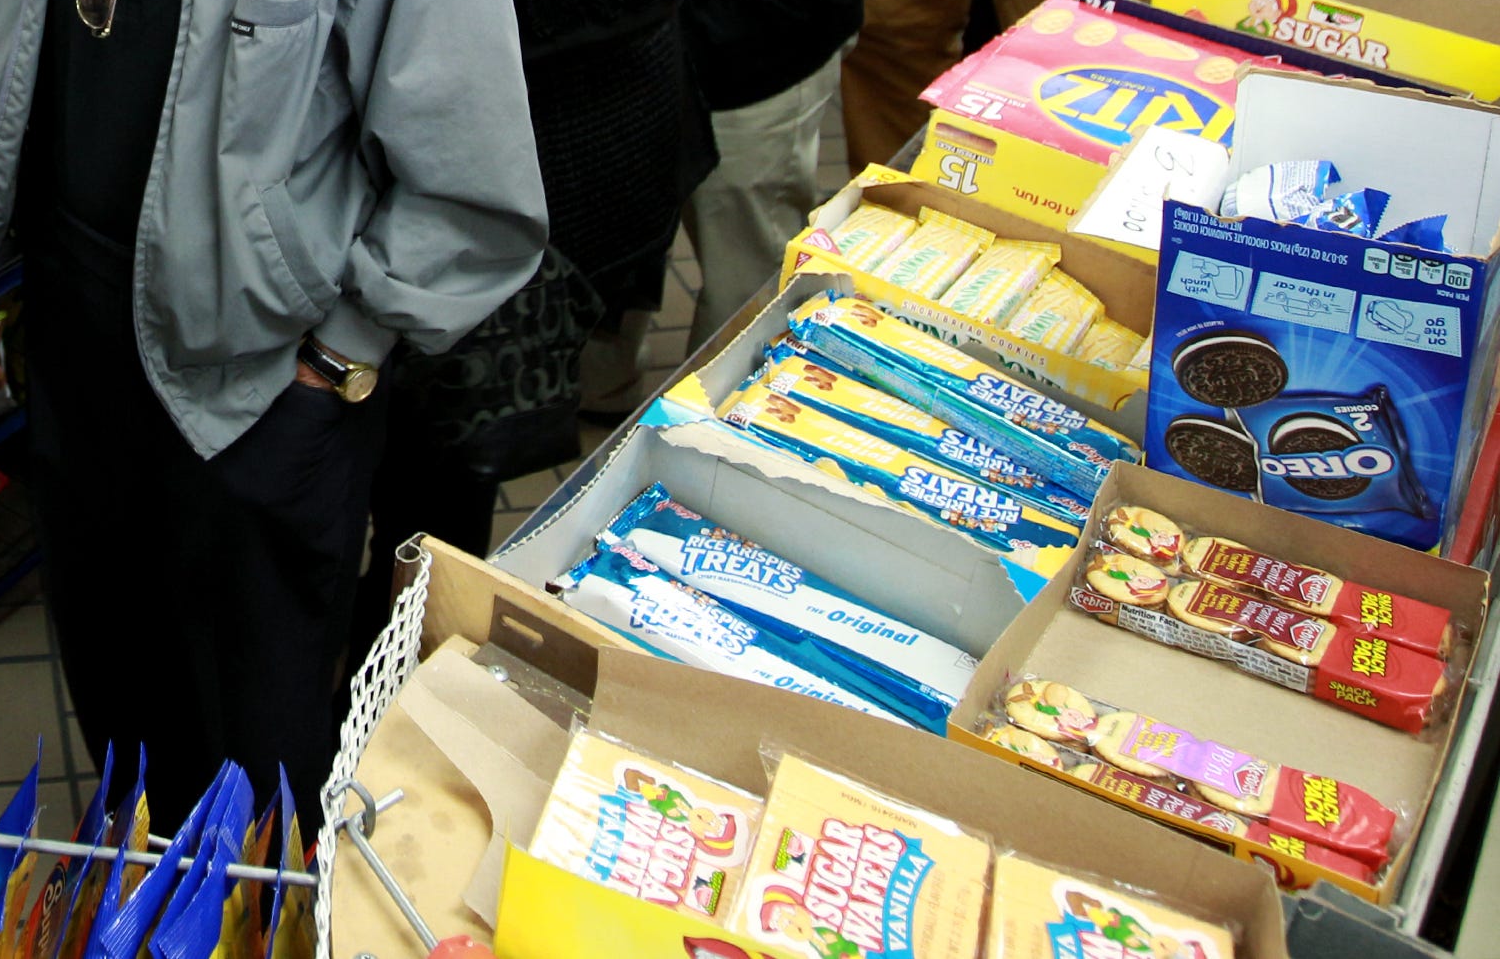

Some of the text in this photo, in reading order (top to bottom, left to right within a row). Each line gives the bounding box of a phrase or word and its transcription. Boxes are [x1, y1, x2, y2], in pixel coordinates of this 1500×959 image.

[1274, 15, 1390, 70] SUGAR
[1089, 73, 1156, 92] CRACKERS
[955, 94, 1004, 121] 15
[1050, 74, 1235, 143] RITZ
[938, 154, 980, 195] 15
[1011, 185, 1041, 205] fun.
[1040, 195, 1061, 213] for
[1172, 219, 1200, 236] COOKIES
[1200, 225, 1233, 243] SANDWICH
[1234, 232, 1270, 251] CHOCOLATE
[1269, 240, 1291, 255] PACKS
[1180, 277, 1211, 289] lunch
[1184, 284, 1209, 295] with
[1271, 280, 1337, 300] in the car
[1447, 276, 1469, 288] 100
[1456, 293, 1470, 302] PER
[902, 300, 1047, 367] SHORTBREAD COOKIES
[1424, 327, 1448, 338] the
[1426, 317, 1445, 329] go
[1428, 337, 1447, 348] on
[967, 386, 1086, 430] RICE KRISPIES
[979, 372, 1091, 422] TREATS
[1333, 405, 1379, 414] COOKIES
[1350, 413, 1374, 432] 2
[938, 439, 1019, 479] KRISPIES
[1262, 447, 1394, 479] OREO
[898, 479, 1019, 524] RICE KRISPIES
[906, 464, 1023, 515] TREATS
[680, 547, 798, 595] TREATS
[687, 535, 804, 579] RICE KRISPIES
[1071, 587, 1114, 614] Keebler
[1359, 591, 1380, 629] PACK
[1376, 592, 1394, 629] SNACK
[805, 605, 919, 647] THE Original
[1121, 604, 1181, 630] Nutrition Facts
[1351, 637, 1371, 677] PACK
[1369, 638, 1388, 677] SNACK
[752, 668, 771, 680] THE
[1328, 681, 1372, 700] SNACK
[1335, 689, 1377, 709] PACK
[1302, 773, 1328, 827] PACK
[1318, 777, 1340, 825] SNACK
[610, 801, 664, 899] WAFE
[642, 818, 696, 907] SUGA
[803, 817, 865, 934] SUGAR
[840, 823, 907, 954] WAFERS
[888, 854, 930, 952] VANILLA
